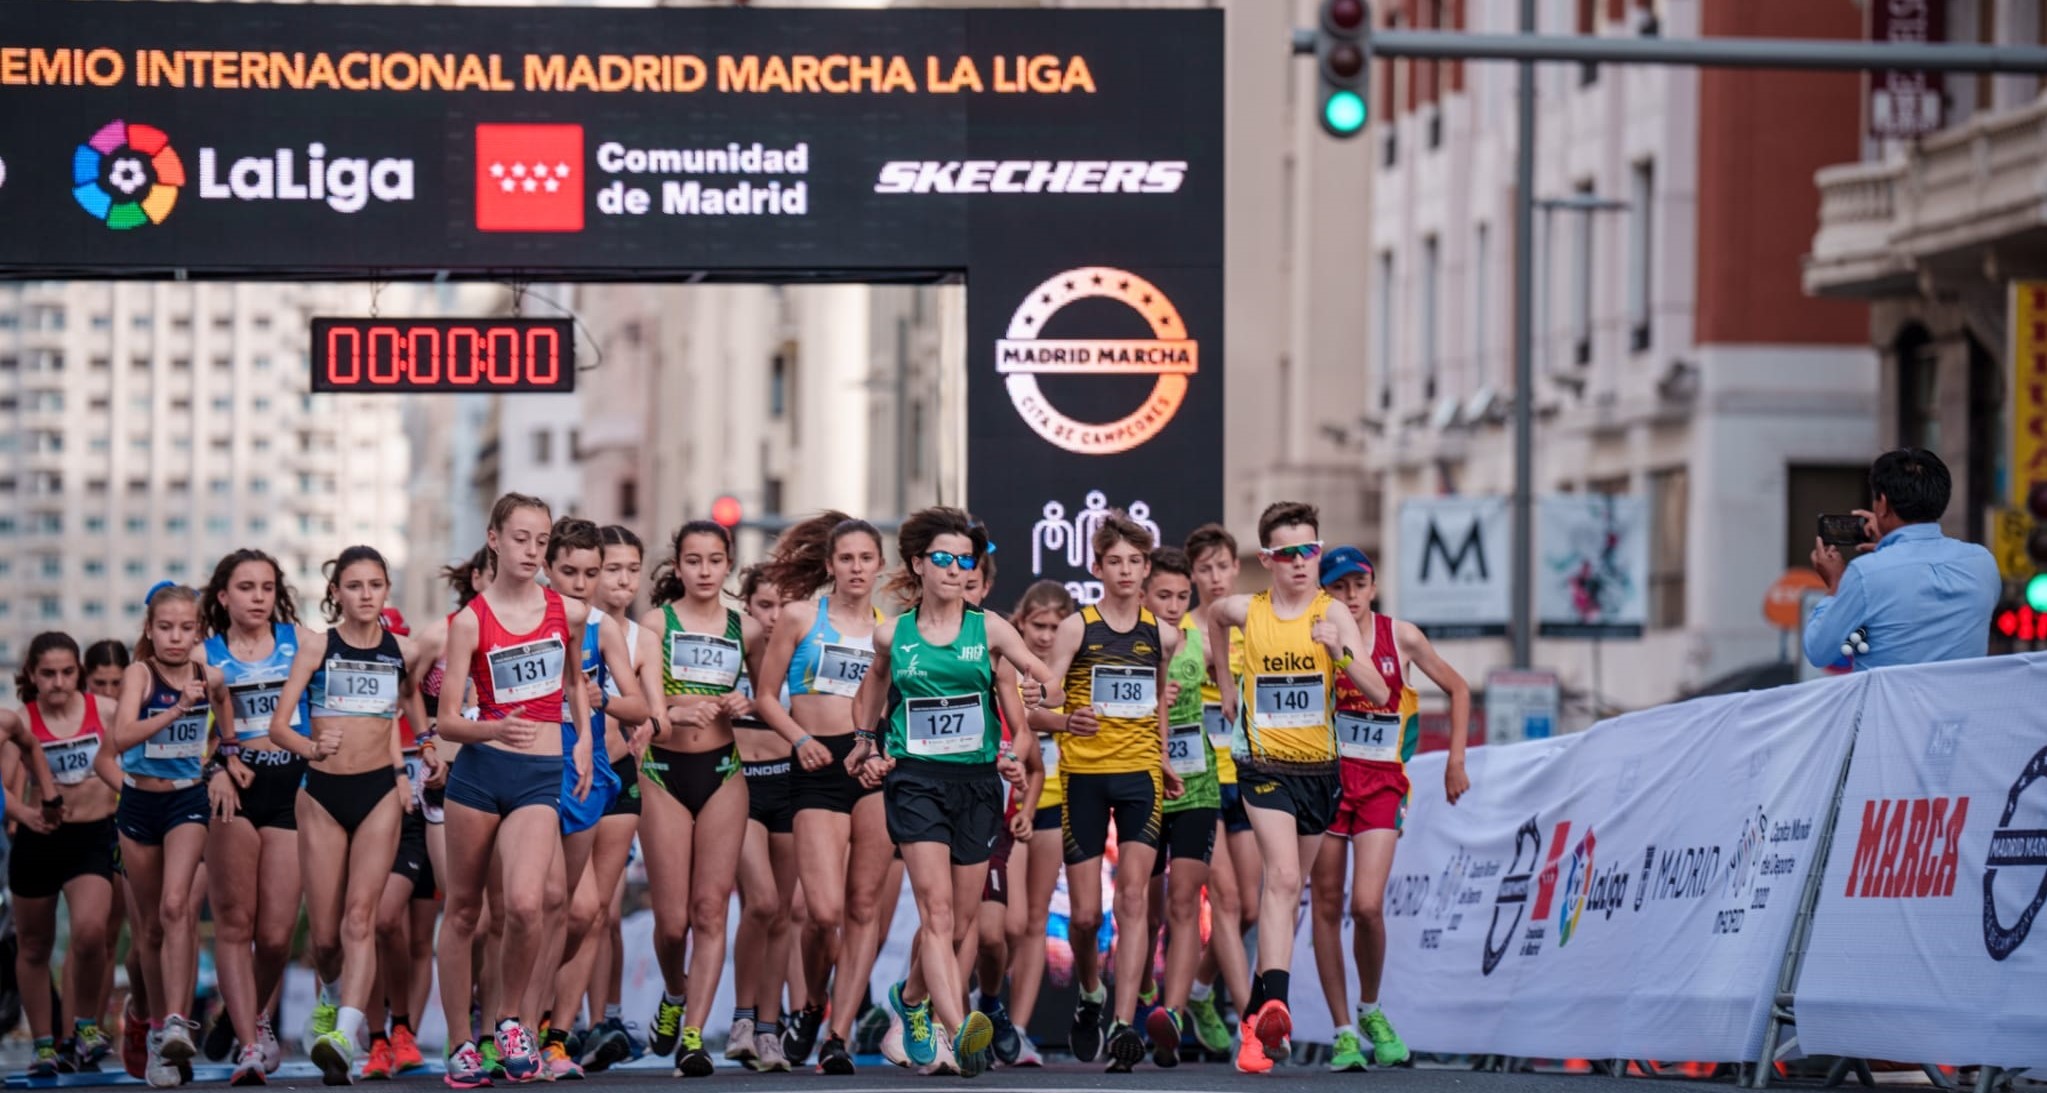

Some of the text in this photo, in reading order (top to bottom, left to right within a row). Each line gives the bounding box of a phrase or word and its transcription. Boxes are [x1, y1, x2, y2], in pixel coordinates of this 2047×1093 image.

[1, 48, 1096, 93] EMIO INTERNACIONAL MADRID MARCHA LA LIGA
[597, 143, 808, 174] Comunidad
[200, 143, 414, 212] LaLiga
[875, 161, 1188, 194] SKECHERS
[597, 182, 807, 214] de Madrid
[328, 327, 559, 384] 00:00:00
[1004, 348, 1190, 364] MADRID MARCHA
[1022, 396, 1170, 444] CITA DE CAMPEONES
[691, 648, 723, 667] 124
[1263, 652, 1316, 671] teika
[512, 658, 547, 682] 131
[839, 660, 869, 681] 135
[346, 675, 379, 695] 129
[1111, 682, 1142, 700] 138
[247, 695, 280, 714] 130
[1273, 691, 1309, 710] 140
[168, 723, 197, 742] 105
[927, 713, 964, 735] 127
[1351, 724, 1383, 744] 114
[58, 751, 88, 771] 128
[255, 750, 291, 766] PRO
[742, 763, 791, 777] UNDER
[1845, 796, 1970, 898] MARCA
[1652, 846, 1720, 900] MADRID
